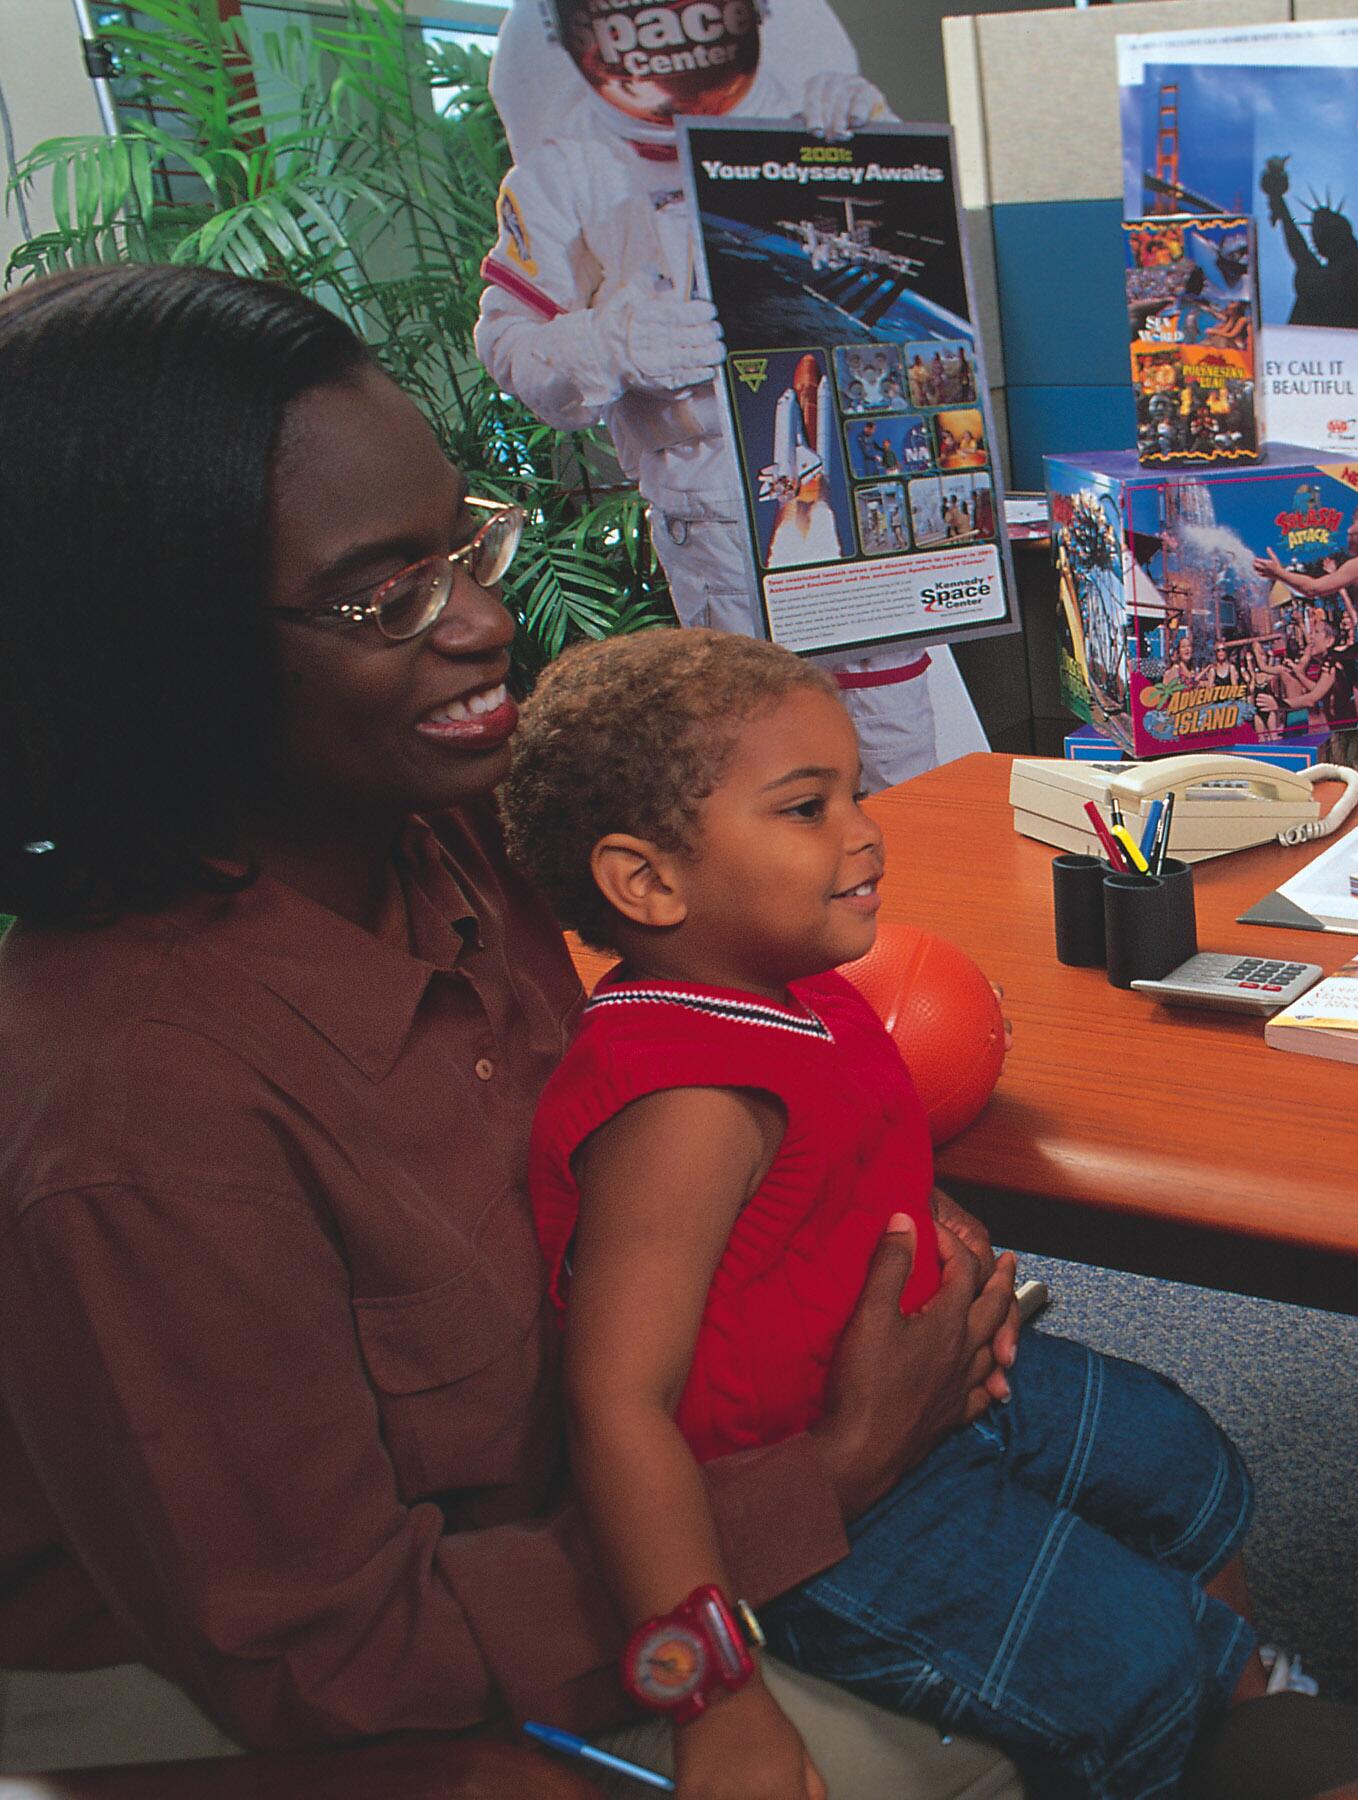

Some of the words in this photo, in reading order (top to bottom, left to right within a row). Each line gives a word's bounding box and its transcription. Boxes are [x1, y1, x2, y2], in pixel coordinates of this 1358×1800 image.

[702, 161, 760, 180] Your
[762, 161, 866, 184] Odyssey
[865, 163, 945, 182] Awaits
[1265, 360, 1282, 376] EY
[1287, 360, 1324, 376] CALL
[1329, 360, 1344, 376] IT
[1271, 379, 1355, 396] BEAUTIFUL
[1274, 507, 1344, 536] SPLASH
[1287, 528, 1331, 550] ATTACK
[935, 576, 984, 590] Kennedy
[920, 583, 991, 606] Space
[945, 598, 982, 609] Center
[1167, 684, 1248, 713] ADVENTURE
[1172, 705, 1240, 736] ISLAND
